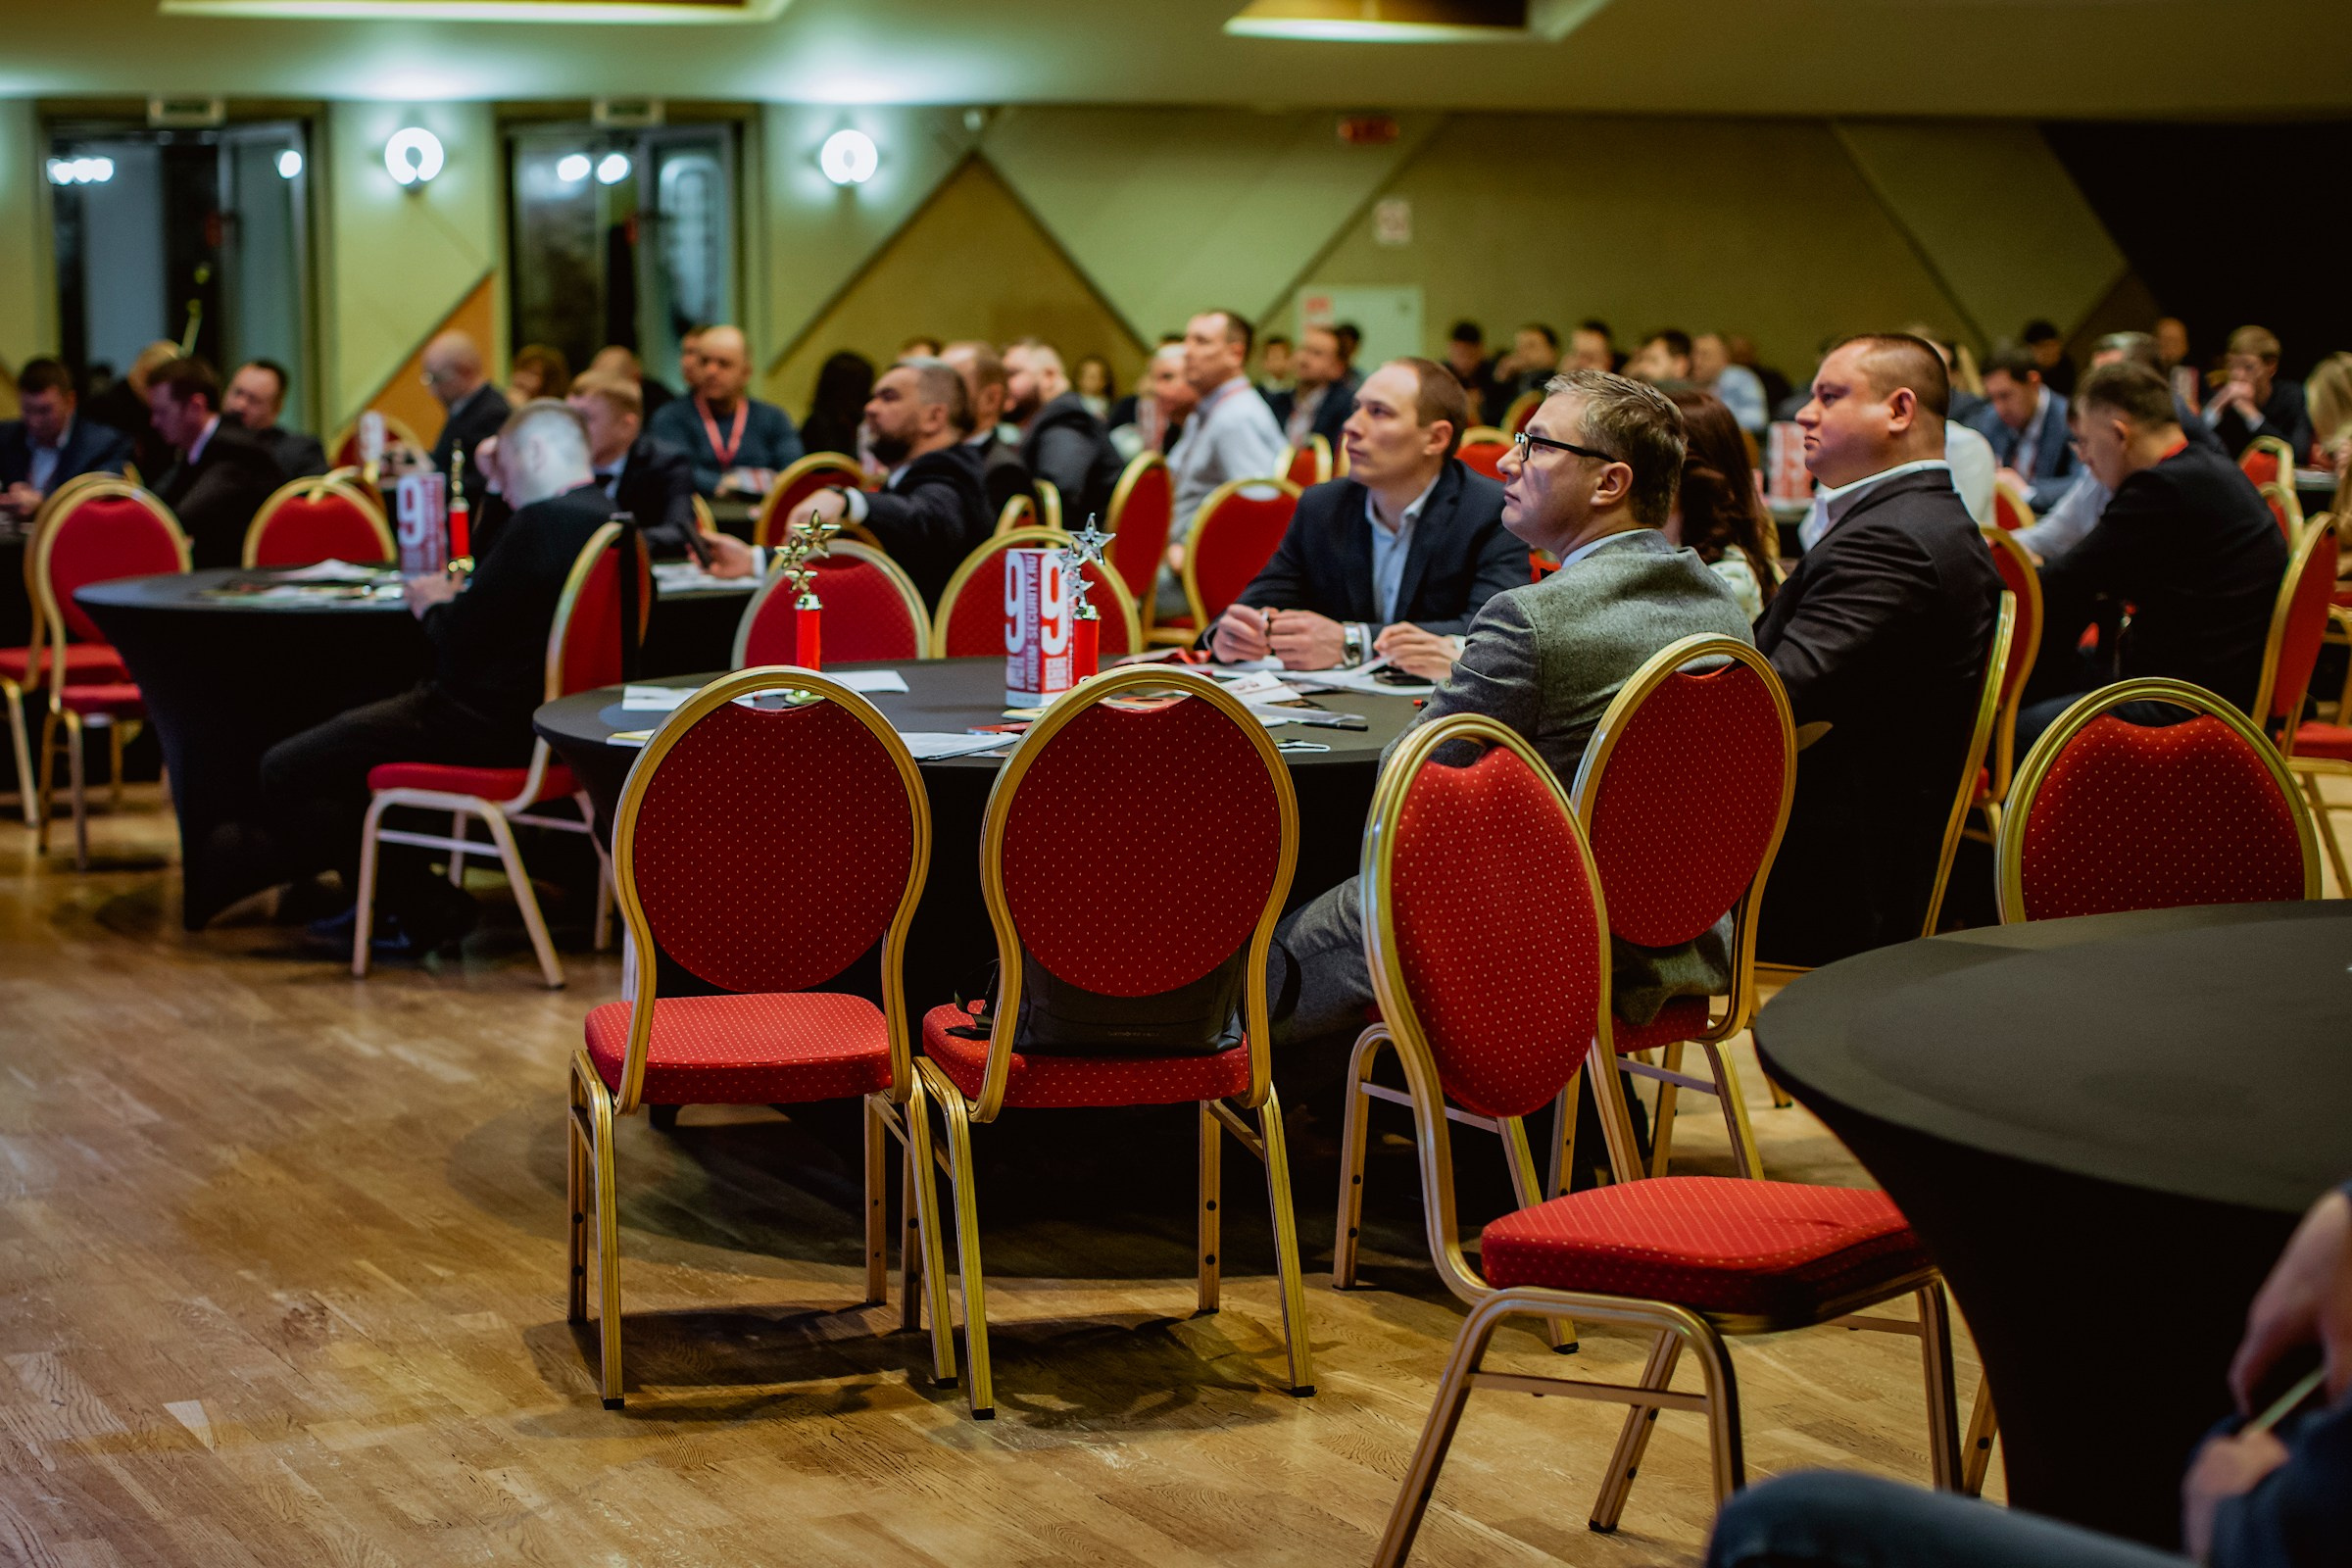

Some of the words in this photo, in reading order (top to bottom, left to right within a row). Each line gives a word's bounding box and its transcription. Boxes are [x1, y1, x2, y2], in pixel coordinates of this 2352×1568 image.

[398, 475, 423, 545] 9
[1005, 552, 1026, 654] 9
[1041, 551, 1068, 656] 9
